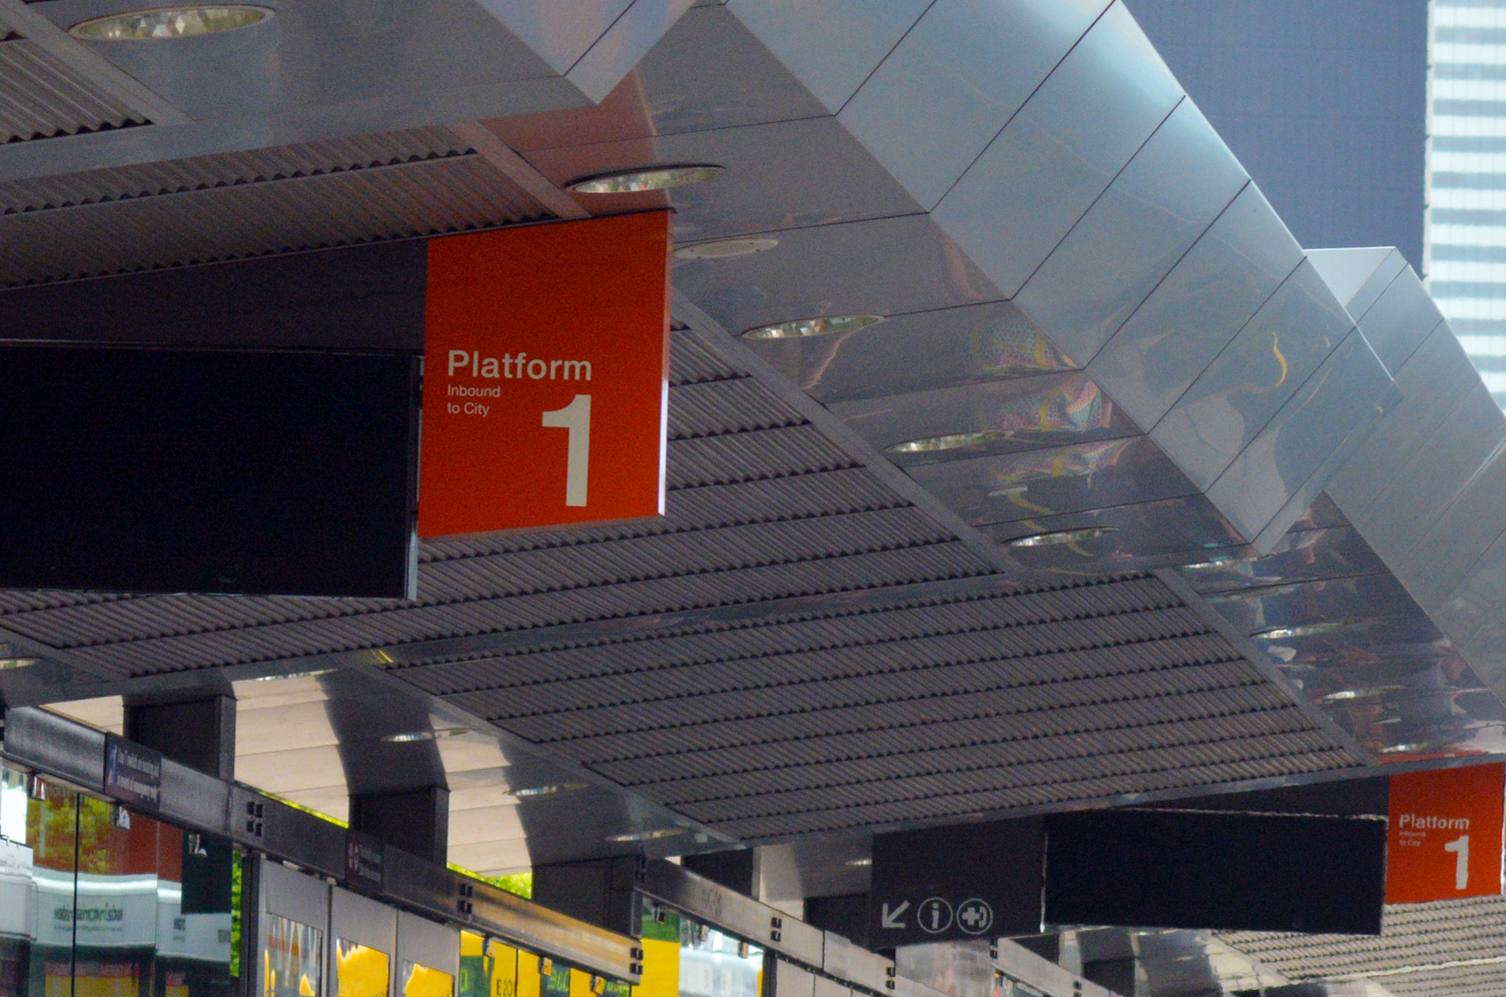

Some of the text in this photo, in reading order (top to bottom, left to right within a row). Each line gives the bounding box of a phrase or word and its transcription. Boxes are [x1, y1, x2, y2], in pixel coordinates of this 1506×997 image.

[448, 349, 592, 381] Platform
[447, 384, 501, 398] Inbound
[447, 402, 490, 418] to City
[542, 393, 592, 507] 1
[1399, 813, 1470, 830] Platform
[1444, 834, 1470, 890] 1
